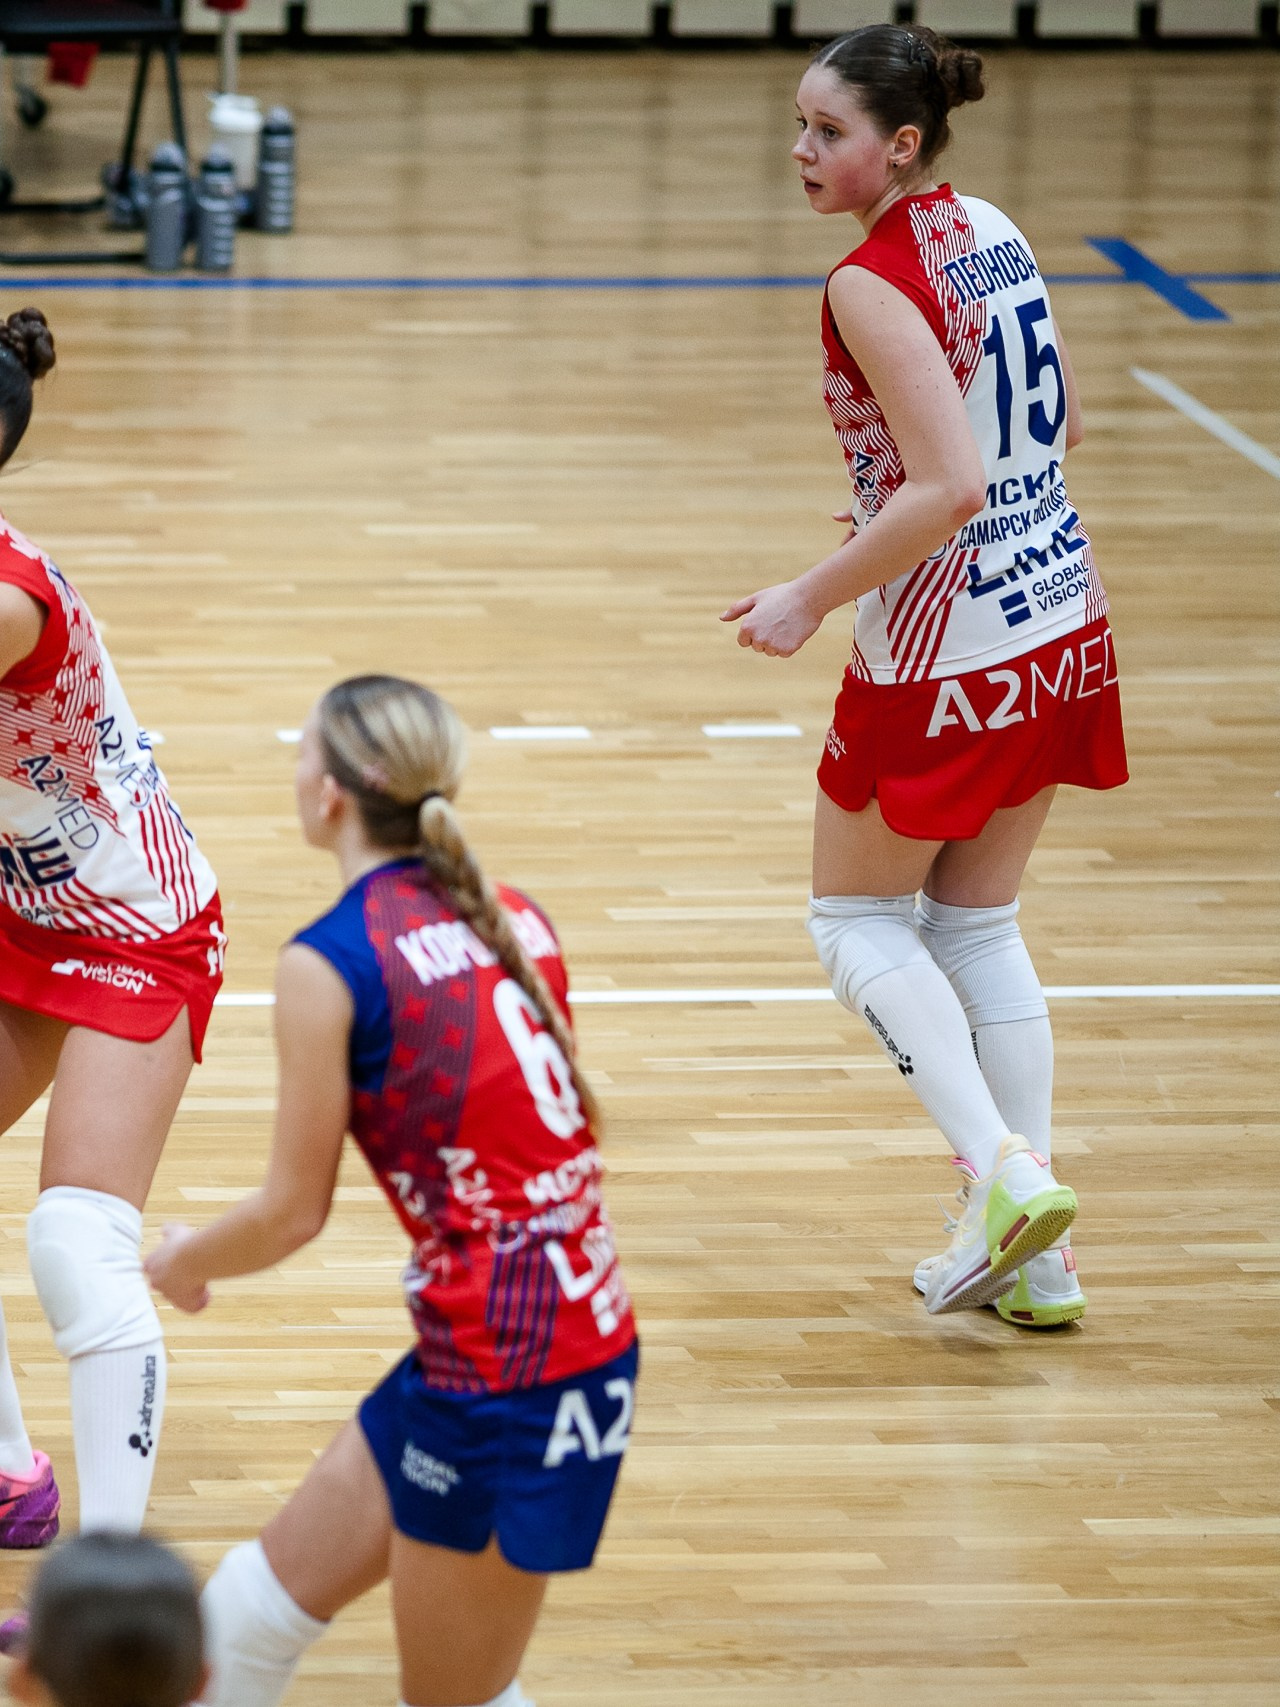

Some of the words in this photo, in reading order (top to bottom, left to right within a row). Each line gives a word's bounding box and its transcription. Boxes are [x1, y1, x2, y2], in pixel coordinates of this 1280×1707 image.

[943, 238, 1040, 306] ЛЕОНОВА
[982, 297, 1066, 460] 15
[958, 510, 1032, 549] САМАРСК
[1032, 559, 1089, 597] GLOBAL
[1036, 577, 1091, 612] VISION
[21, 754, 99, 850] A2MED
[81, 963, 144, 995] VISION
[492, 977, 587, 1140] 6
